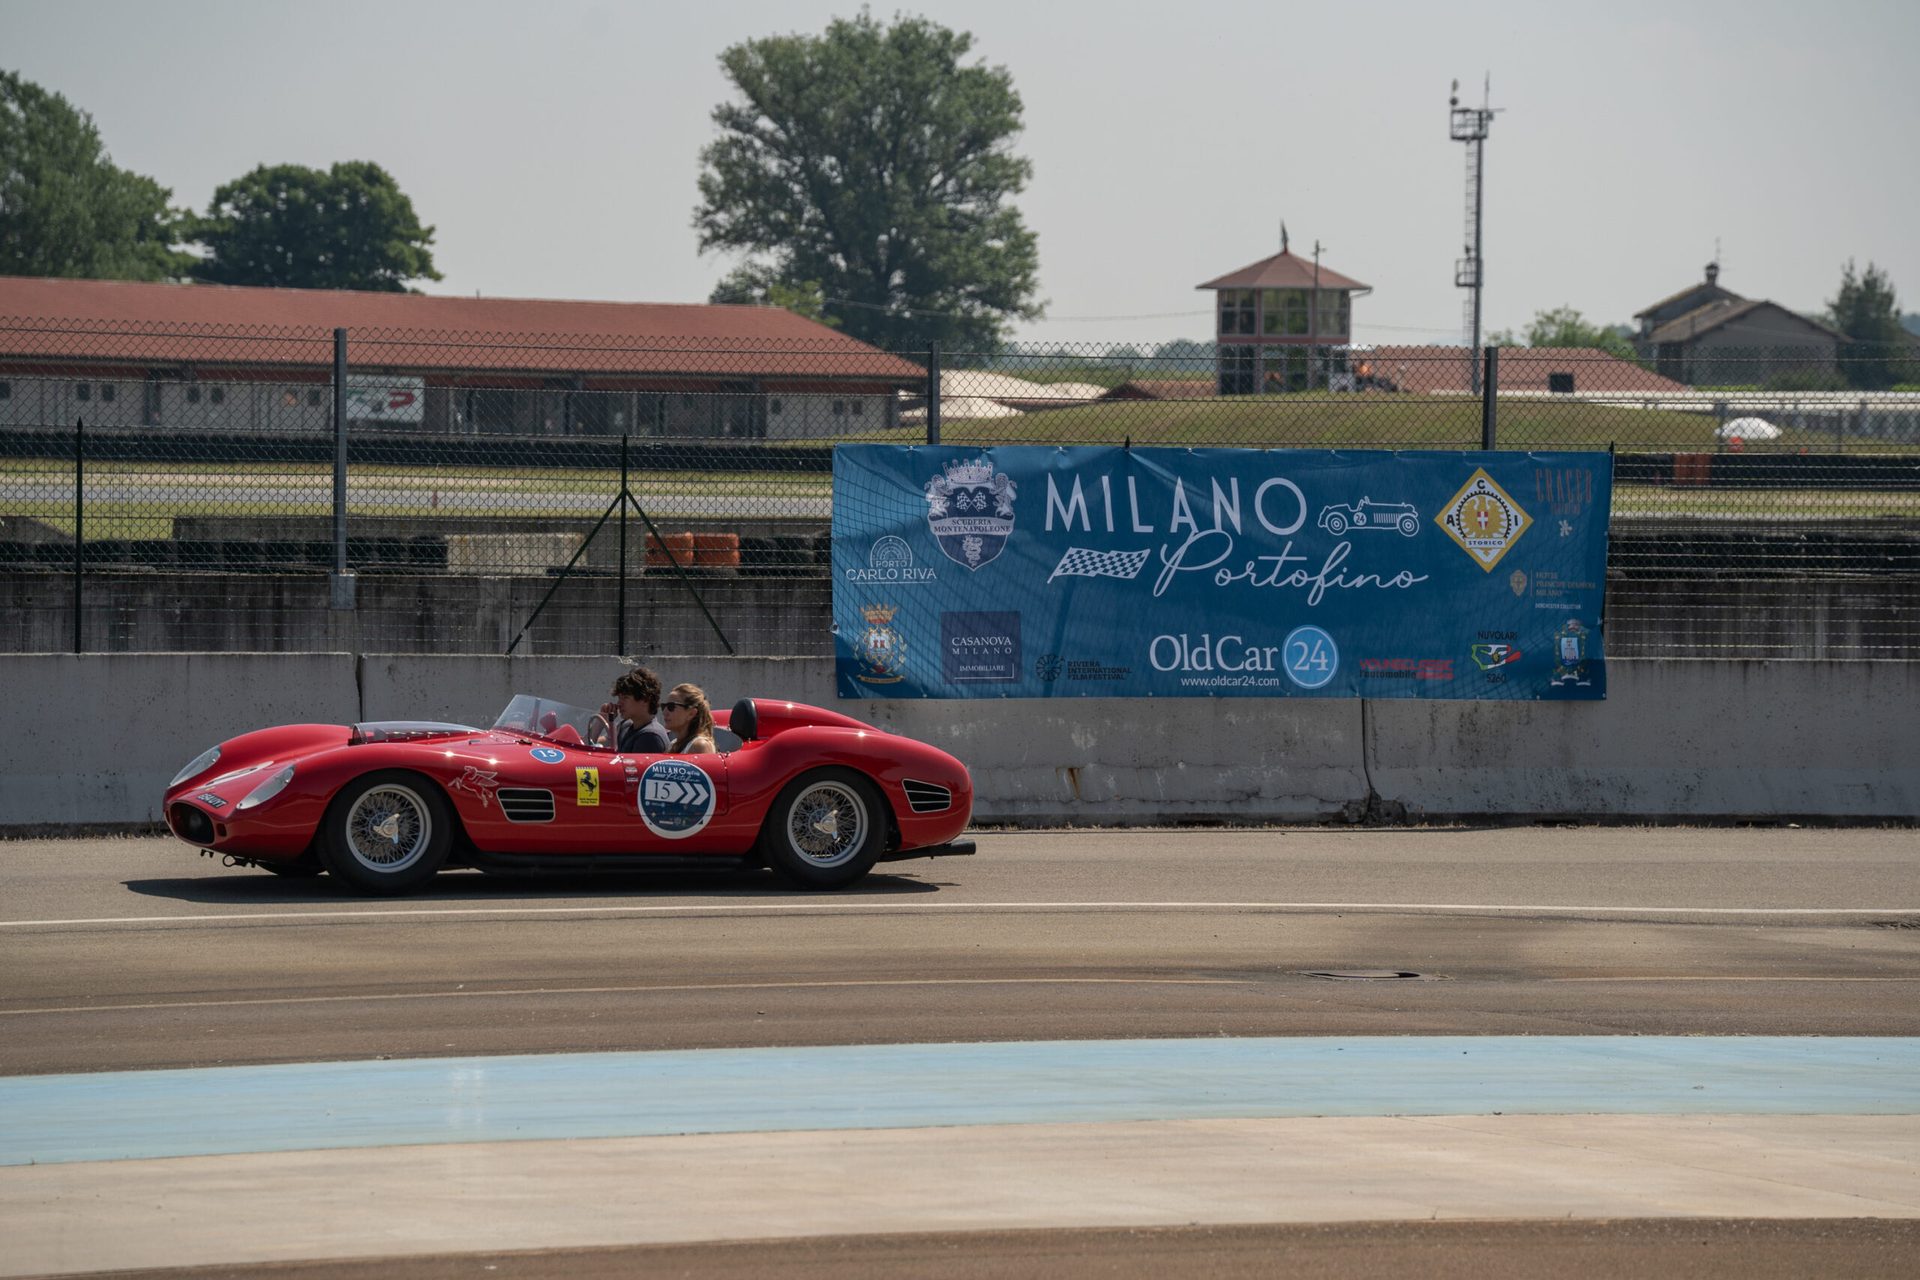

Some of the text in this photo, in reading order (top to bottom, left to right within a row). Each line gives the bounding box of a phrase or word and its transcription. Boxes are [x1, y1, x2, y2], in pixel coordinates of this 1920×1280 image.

[1045, 472, 1307, 536] MILANO
[934, 525, 1011, 533] MONTENAPOLEONE
[875, 560, 908, 568] PORTO
[1152, 529, 1429, 607] Portofino
[845, 567, 938, 581] CARLO RIVA
[951, 636, 1012, 646] CASANOVA
[952, 647, 1012, 655] MILANO
[1292, 639, 1329, 671] 24
[1180, 675, 1280, 688] www.oldcar24.com
[538, 749, 558, 758] 15
[652, 765, 687, 775] MILANO
[653, 781, 671, 800] 15
